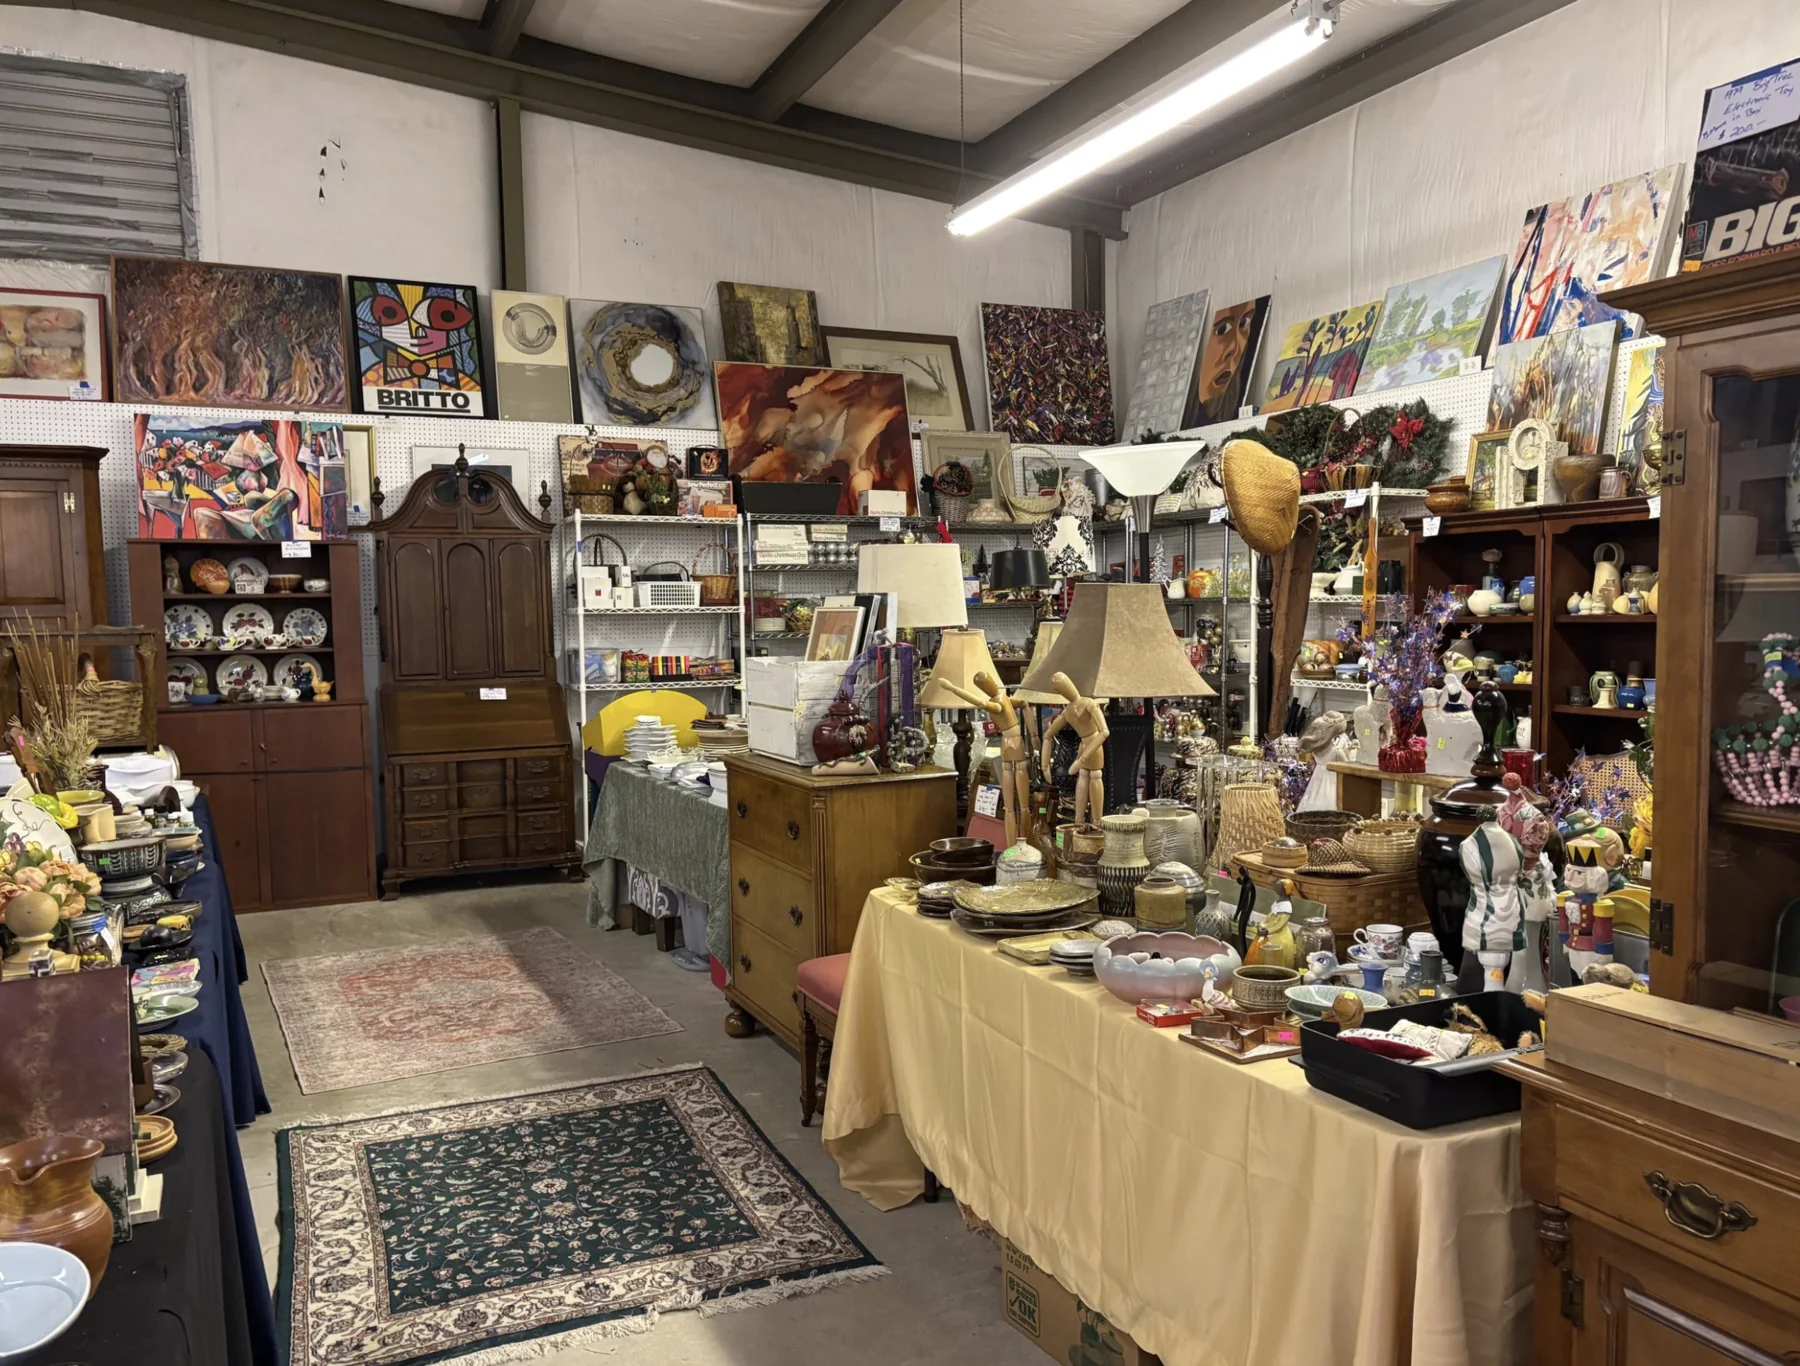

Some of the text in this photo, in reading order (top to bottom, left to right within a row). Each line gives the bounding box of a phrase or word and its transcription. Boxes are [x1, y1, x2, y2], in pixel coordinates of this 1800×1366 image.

[1775, 83, 1794, 97] Toy
[1688, 224, 1704, 241] MB
[1702, 195, 1800, 263] BIG
[376, 388, 470, 409] BRITTO
[1018, 1299, 1037, 1324] OK
